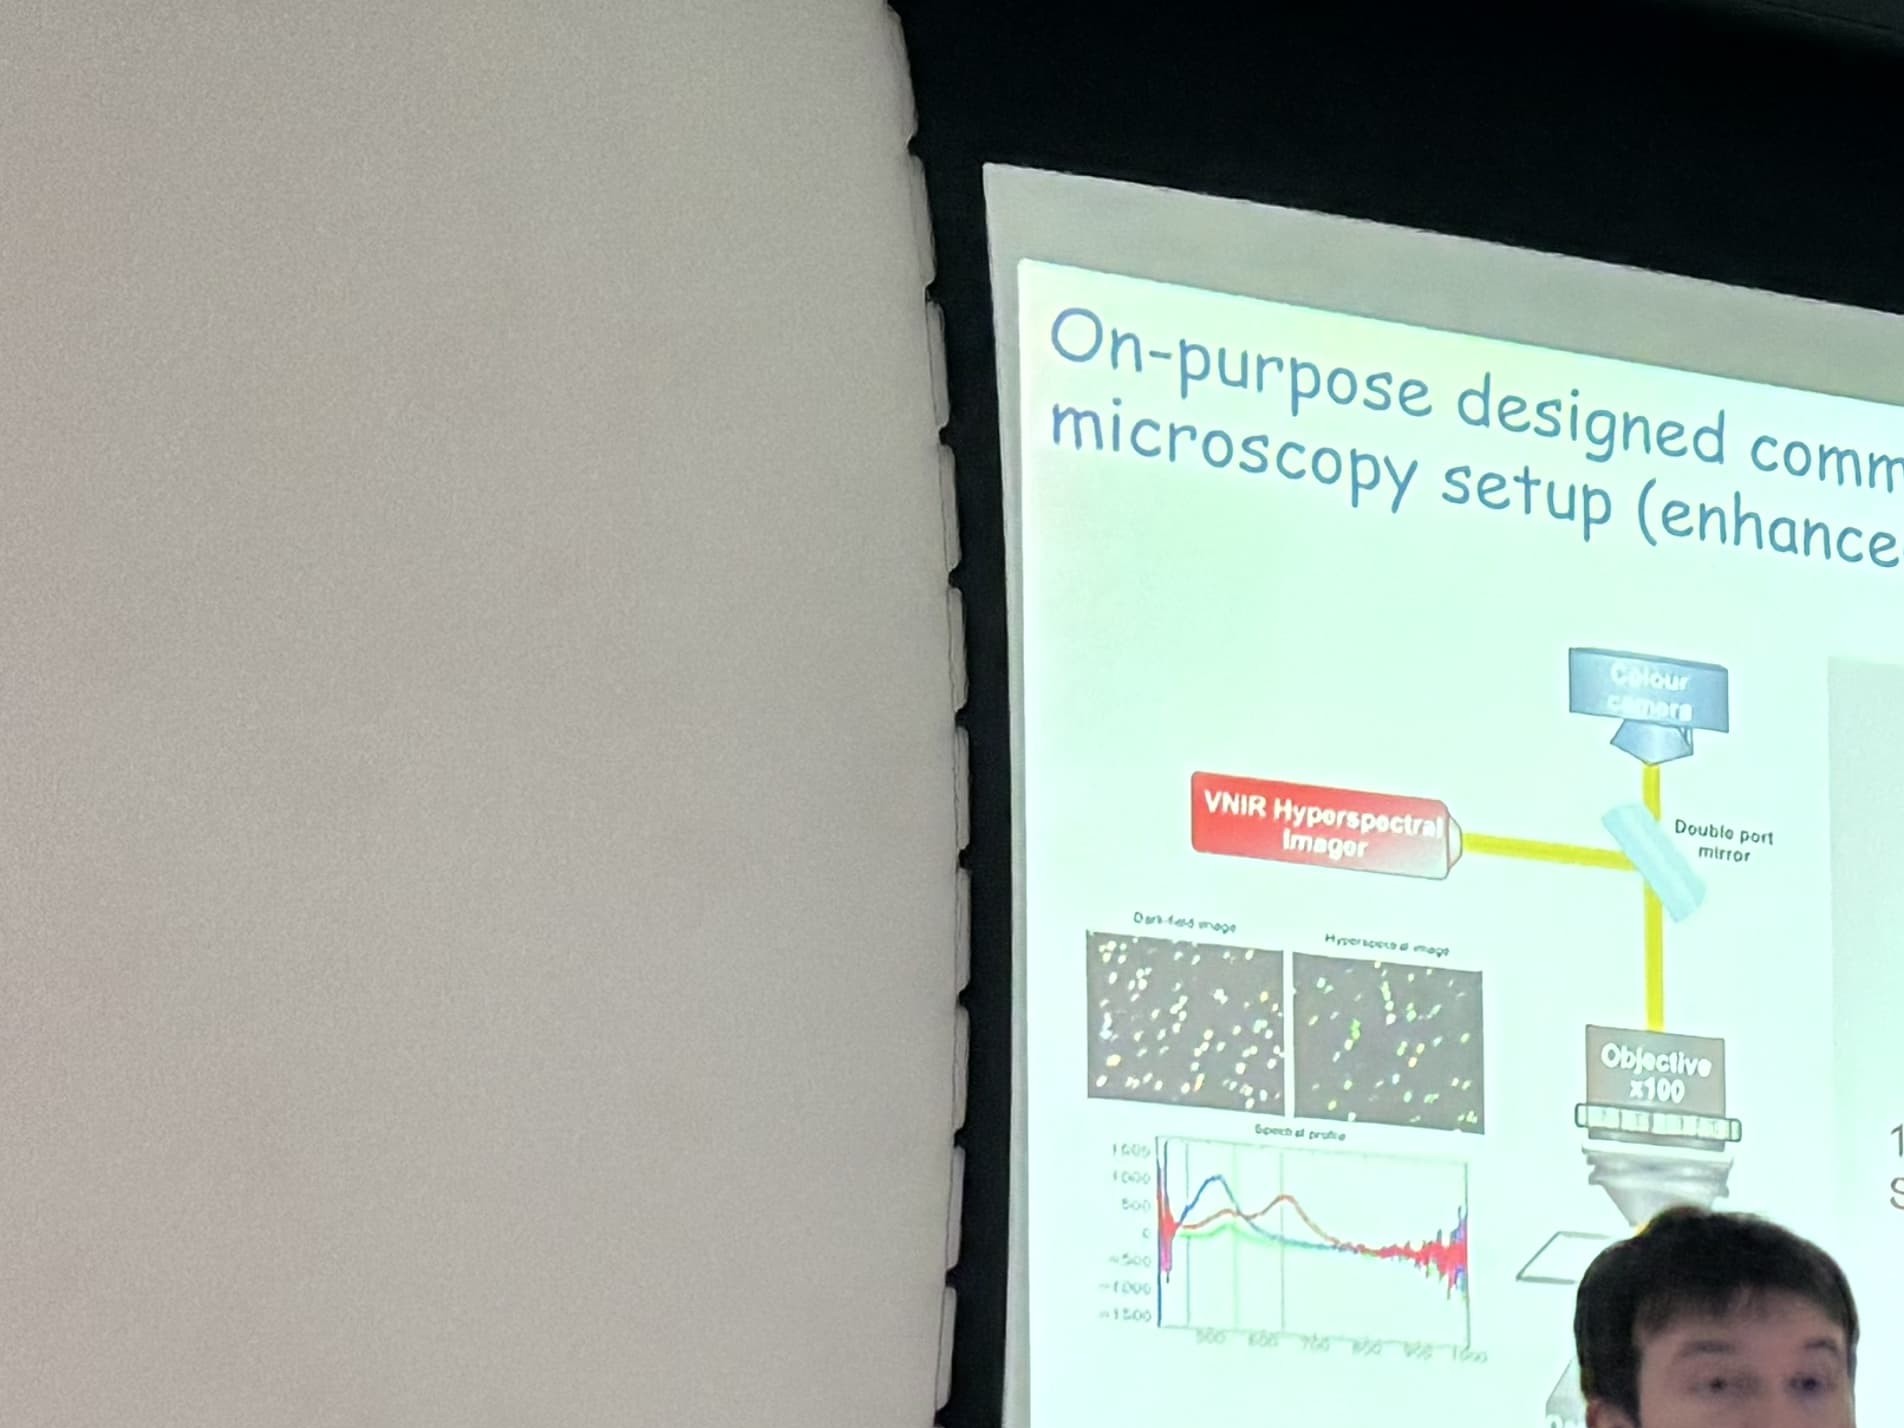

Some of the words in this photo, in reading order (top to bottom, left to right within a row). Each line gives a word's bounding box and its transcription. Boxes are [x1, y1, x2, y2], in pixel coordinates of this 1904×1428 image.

[1050, 306, 1433, 416] On-purpose
[1457, 371, 1726, 464] designed
[1052, 396, 1418, 512] microscopy
[1441, 460, 1612, 542] setup
[1610, 661, 1690, 691] Colour
[1204, 790, 1267, 817] VNIR
[1274, 798, 1444, 838] Hyperspectral
[1283, 828, 1368, 860] Imager
[1675, 818, 1734, 840] Double
[1740, 831, 1773, 846] port
[1699, 846, 1750, 862] mirror
[1601, 1043, 1712, 1078] Objective
[1629, 1076, 1685, 1103] x100
